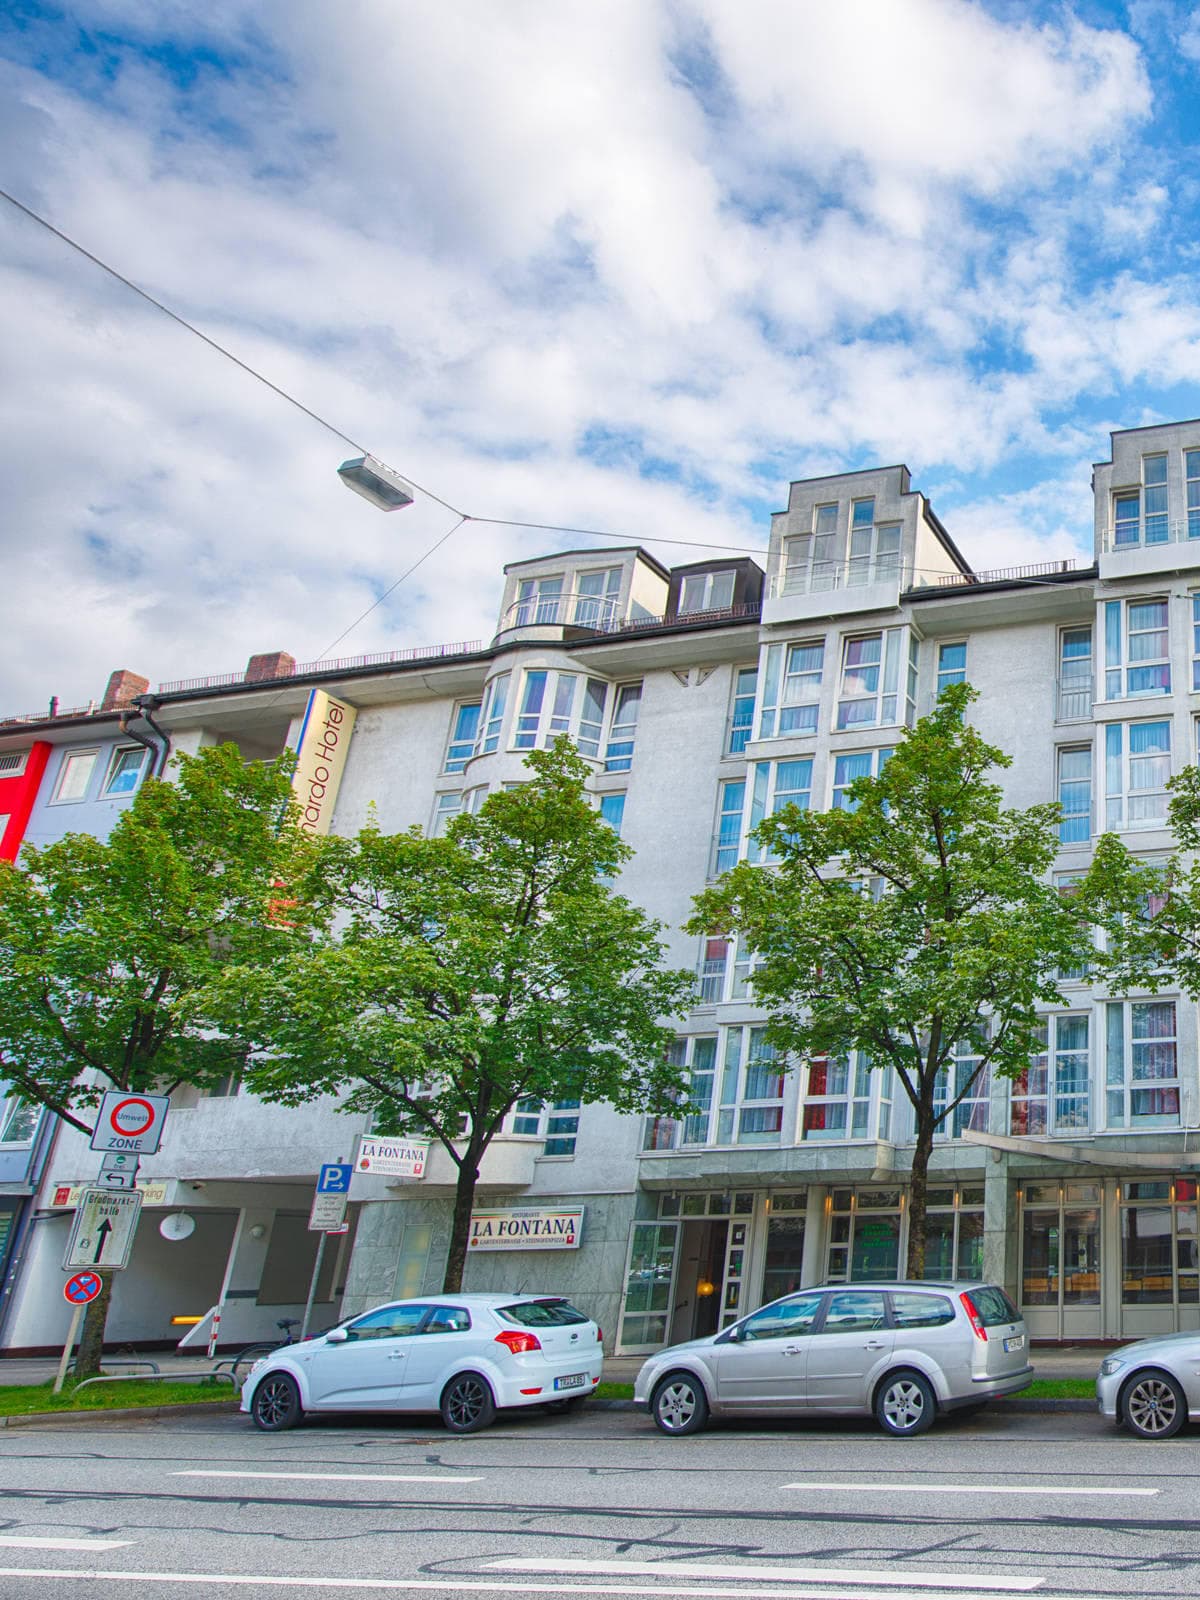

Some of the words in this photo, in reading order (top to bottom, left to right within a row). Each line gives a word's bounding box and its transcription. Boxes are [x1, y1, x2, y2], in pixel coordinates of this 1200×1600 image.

[300, 765, 330, 830] nardo
[315, 699, 345, 762] Hotel
[117, 1112, 148, 1122] Umwelt
[108, 1137, 143, 1150] ZONE
[362, 1144, 375, 1156] LA
[378, 1146, 424, 1161] FONTANA
[322, 1167, 343, 1190] P
[99, 1206, 120, 1216] halle
[473, 1221, 492, 1237] LA
[498, 1218, 575, 1236] FONTANA
